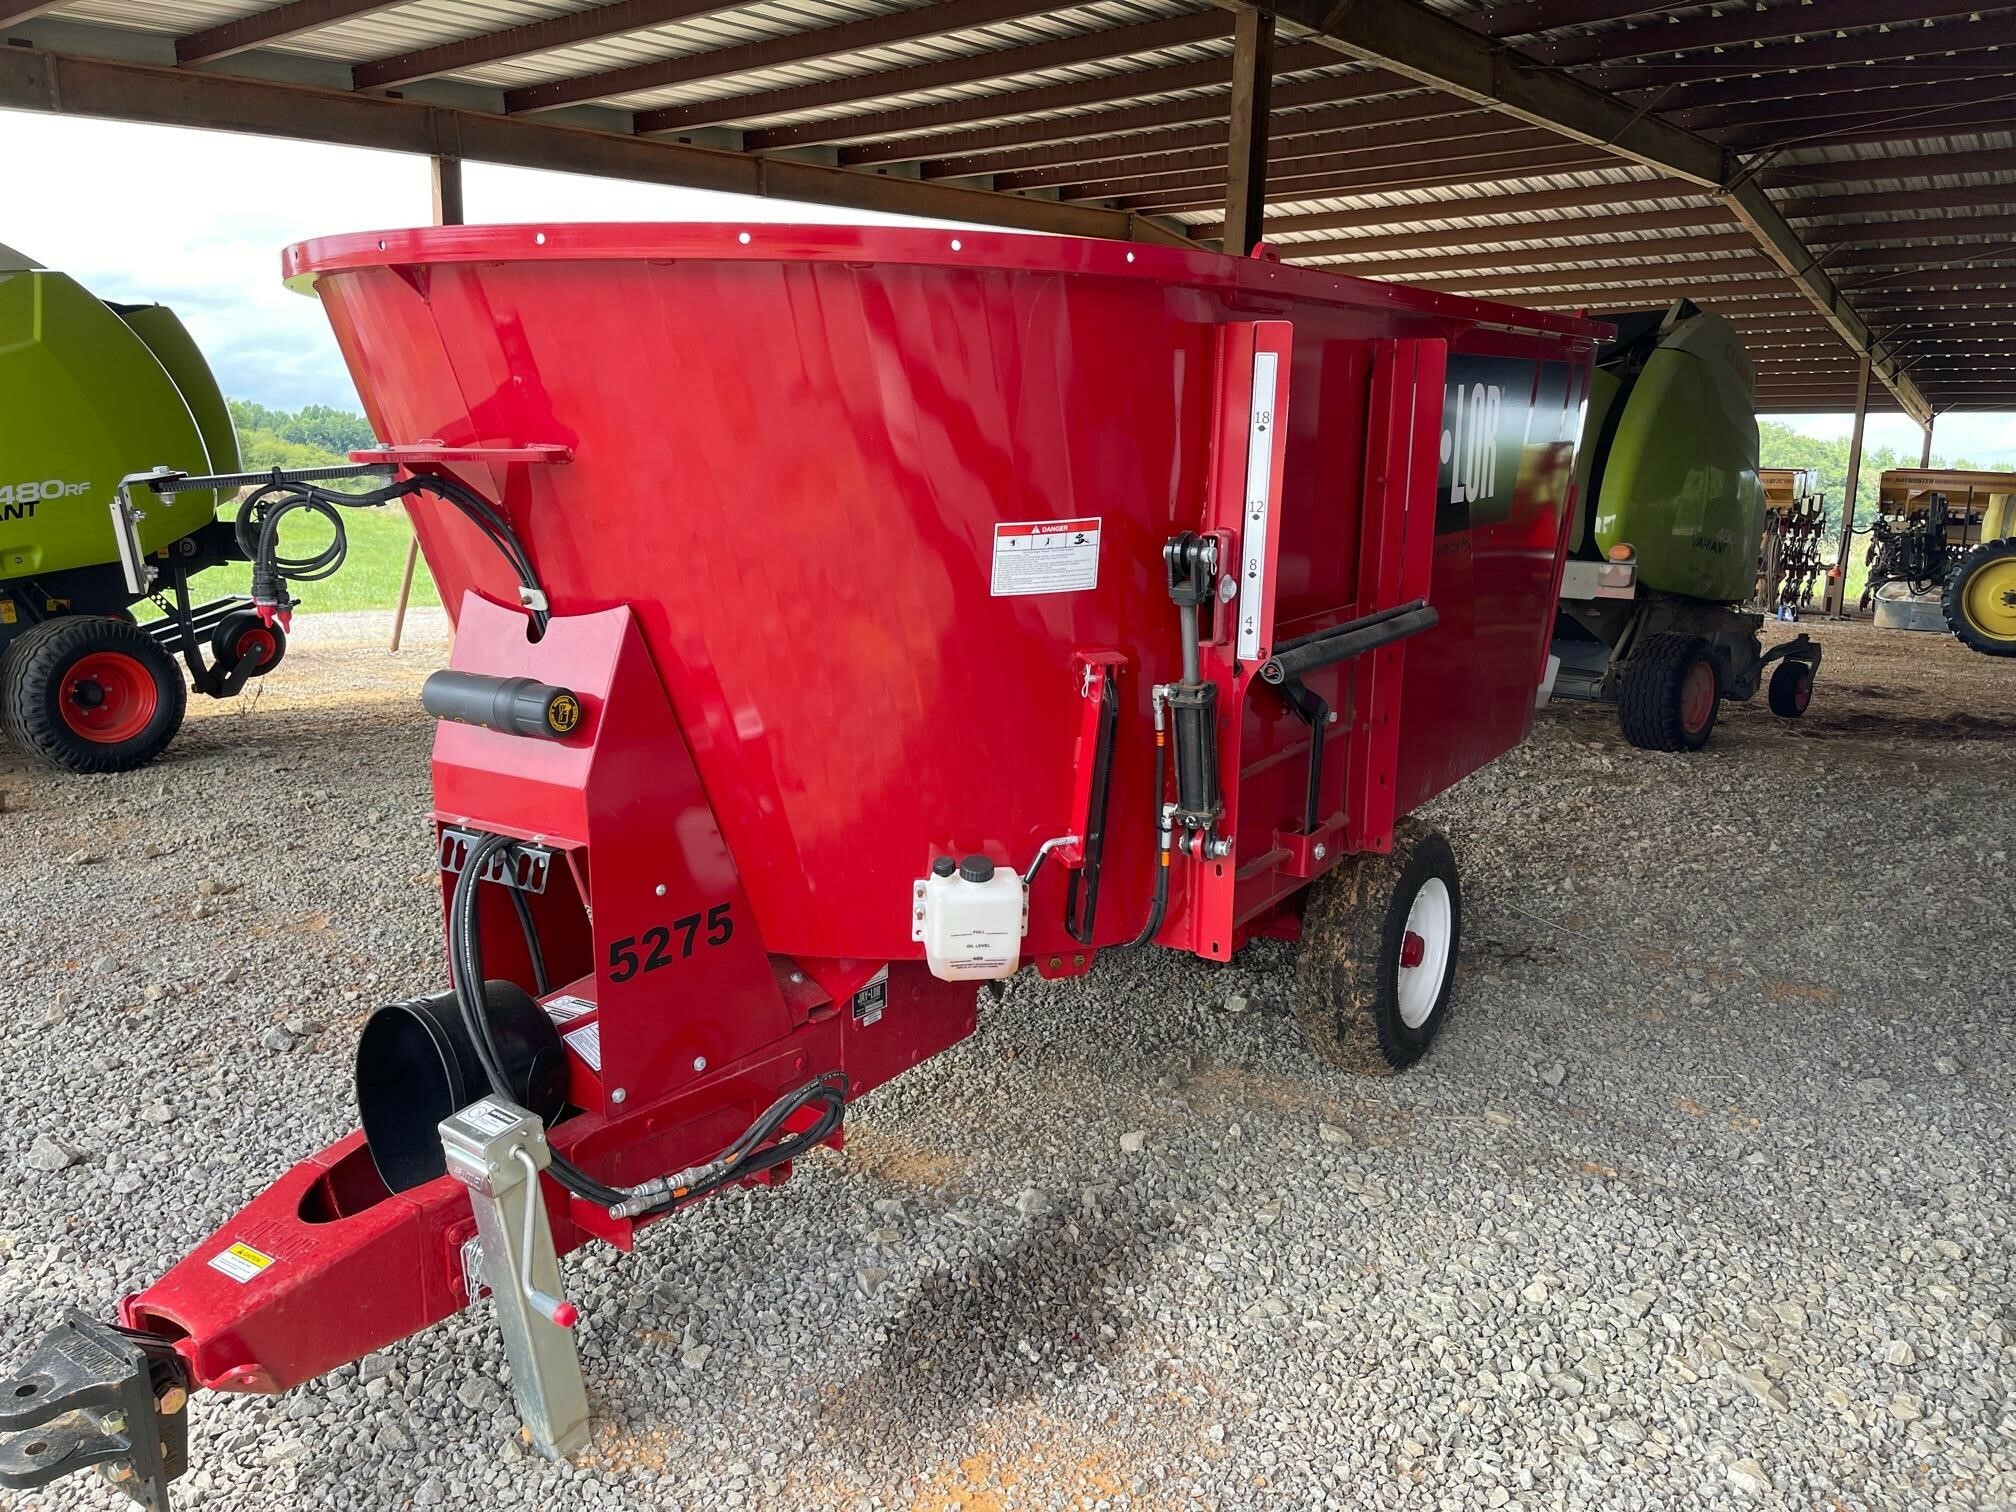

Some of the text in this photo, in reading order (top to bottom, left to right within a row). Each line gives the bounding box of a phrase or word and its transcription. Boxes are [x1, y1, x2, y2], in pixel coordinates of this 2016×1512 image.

[1255, 411, 1270, 424] 18
[1249, 501, 1264, 513] 12
[1041, 525, 1068, 533] DANGER
[1249, 558, 1257, 571] 8
[1245, 616, 1253, 628] 4
[608, 902, 734, 984] 5275
